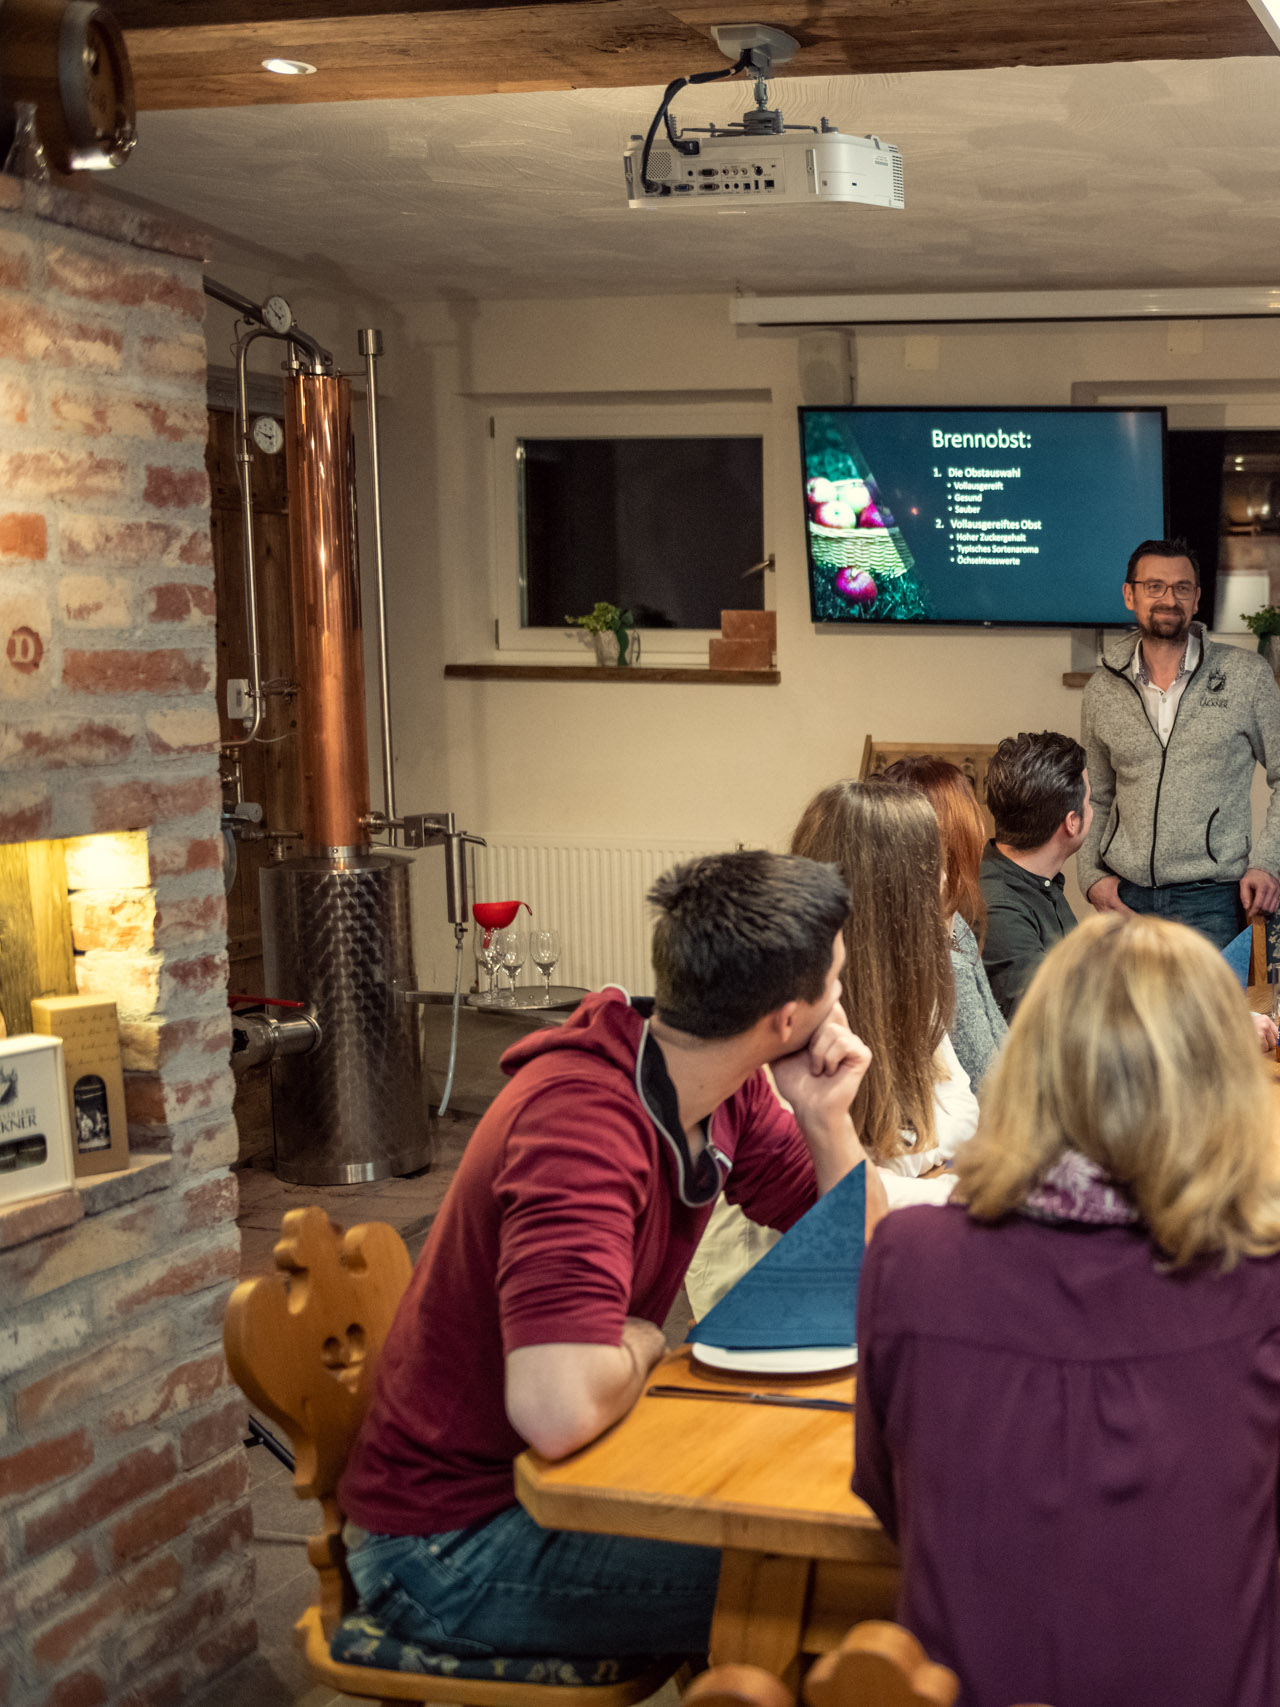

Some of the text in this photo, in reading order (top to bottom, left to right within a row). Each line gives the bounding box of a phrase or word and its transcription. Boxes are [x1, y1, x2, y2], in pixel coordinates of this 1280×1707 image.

[931, 428, 1032, 449] Brennobst:
[933, 467, 1021, 478] 1. Die Obstauswahl
[953, 481, 1004, 491] Vollausgereift
[954, 493, 983, 503] Gesund
[954, 505, 981, 514] Sauber
[935, 518, 1042, 531] 2. Vollausgereiftes Obst
[956, 532, 1027, 544] Hoher Zuckergehalt
[956, 543, 1039, 555] Typisches Sortenaroma
